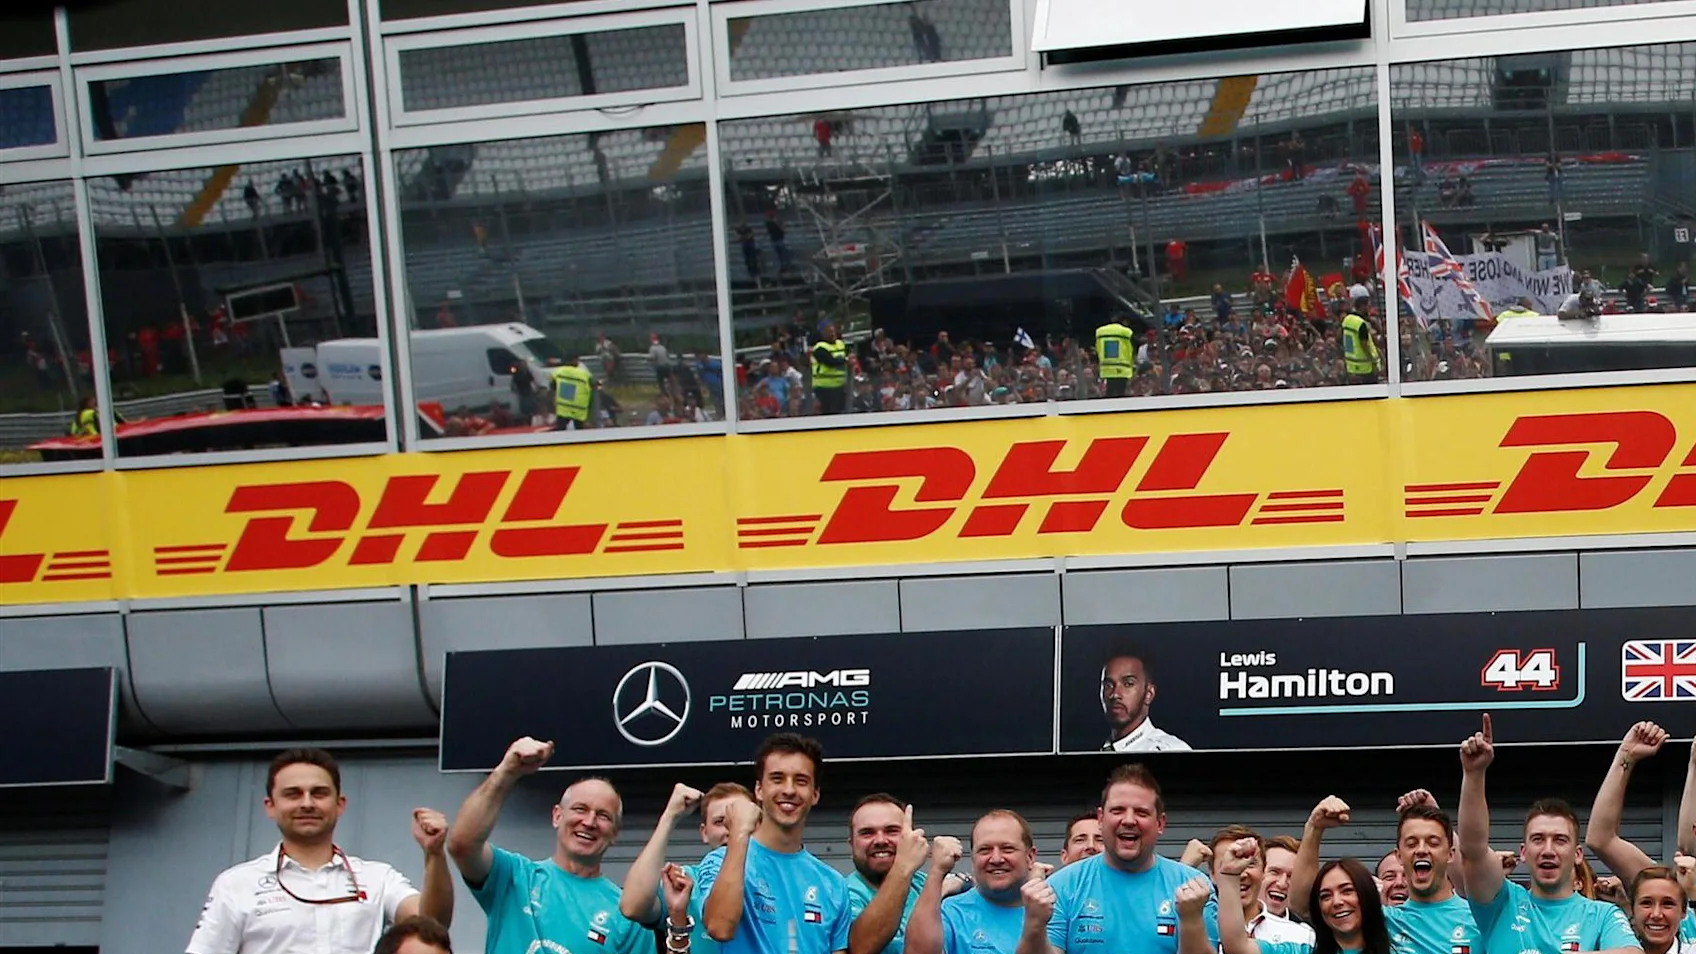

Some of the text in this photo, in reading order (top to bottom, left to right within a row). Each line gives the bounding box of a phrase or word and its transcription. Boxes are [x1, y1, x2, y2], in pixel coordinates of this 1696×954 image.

[817, 433, 1258, 544] DHL
[225, 467, 608, 571] DHL
[1220, 650, 1277, 667] Lewis
[1481, 648, 1560, 692] 44
[779, 668, 871, 688] AMG
[1220, 668, 1394, 699] Hamilton
[709, 691, 869, 712] PETRONAS
[730, 711, 869, 729] MOTORSPORT
